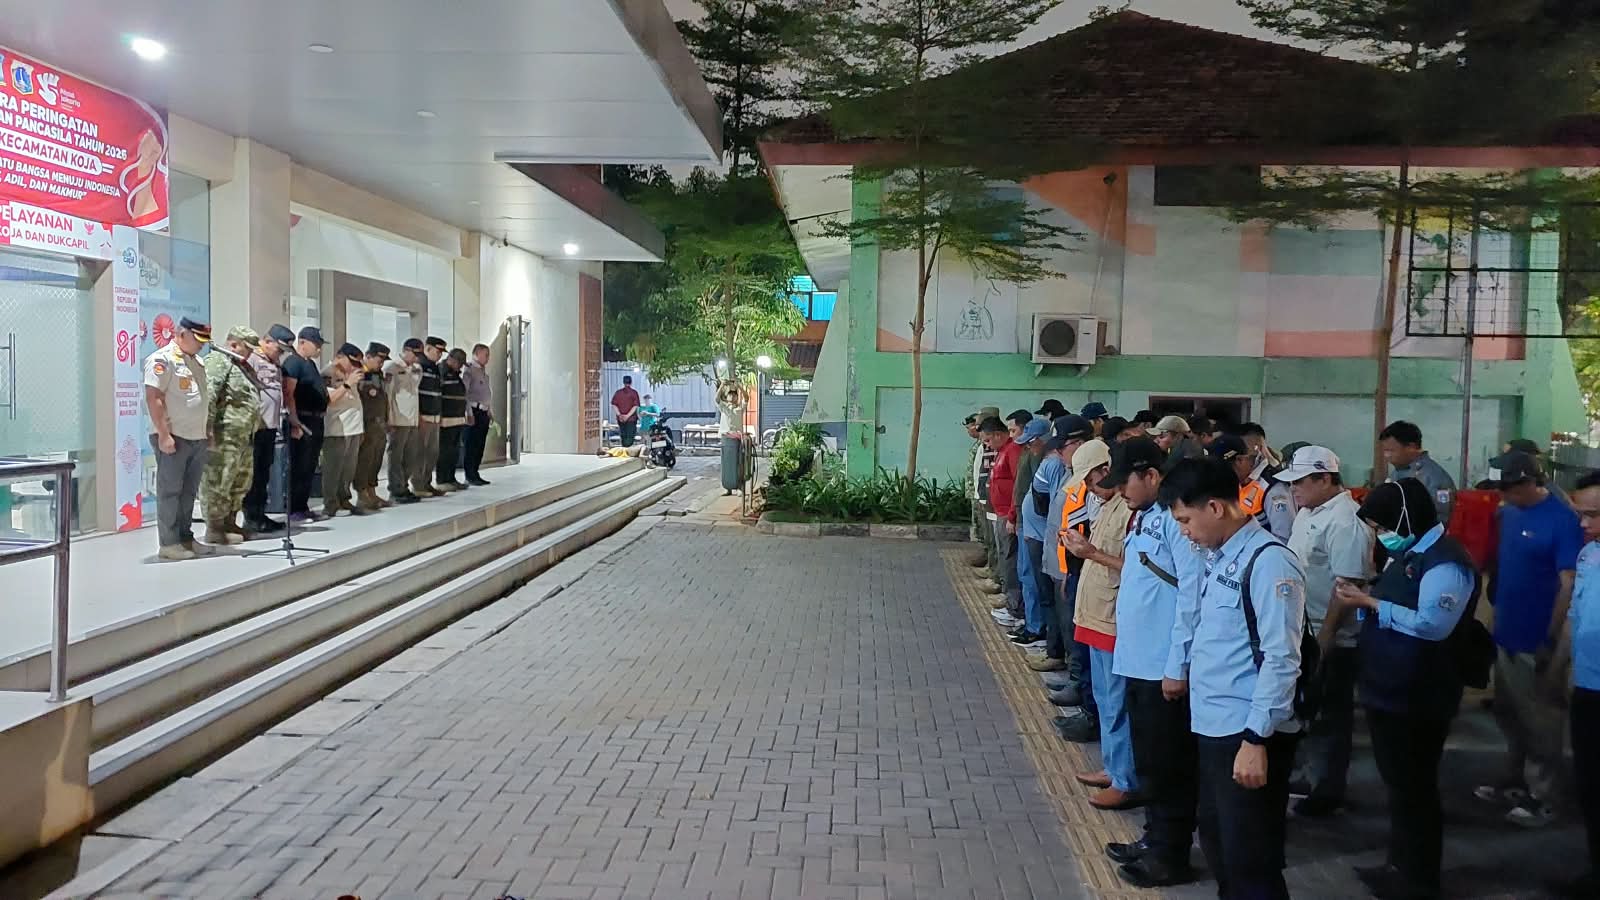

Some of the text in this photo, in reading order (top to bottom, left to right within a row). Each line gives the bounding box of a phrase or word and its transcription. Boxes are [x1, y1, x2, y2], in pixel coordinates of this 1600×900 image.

[15, 114, 73, 145] PANCASILA
[74, 133, 105, 154] TAHUN
[21, 99, 98, 138] PERINGATAN
[0, 131, 97, 171] KECAMATAN KOJA
[4, 173, 27, 188] ADIL,
[29, 178, 48, 192] DAN
[16, 161, 50, 179] BANGSA
[52, 171, 84, 188] MENUJU
[85, 179, 121, 197] INDONESIA
[0, 225, 89, 250] OJA DAN DUKCAPIL
[117, 330, 137, 367] 81
